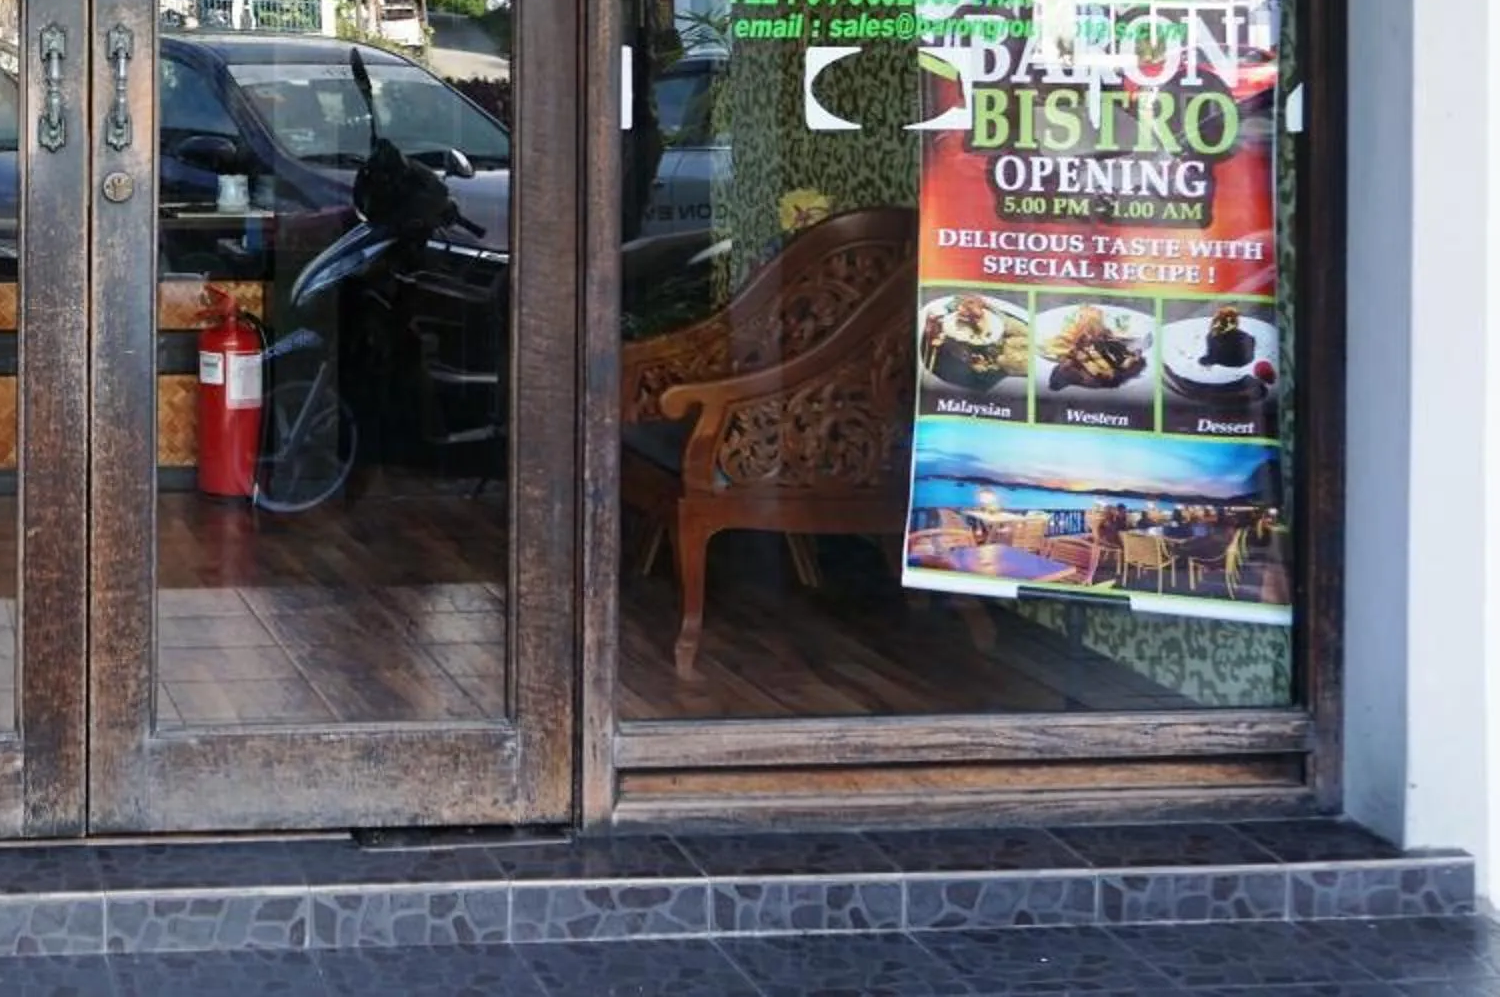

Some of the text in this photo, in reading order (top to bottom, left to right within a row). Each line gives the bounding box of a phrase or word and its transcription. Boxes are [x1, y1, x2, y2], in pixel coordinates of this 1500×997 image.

[734, 13, 806, 39] email
[970, 86, 1241, 155] BISTRO
[994, 155, 1208, 197] OPENING
[1003, 196, 1047, 214] 5.00
[1052, 198, 1090, 216] PM
[1162, 202, 1204, 220] AM
[936, 228, 1265, 261] DELICIOUS TASTE WITH
[983, 255, 1095, 280] SPECIAL
[1102, 264, 1202, 284] RECIPE
[937, 397, 1013, 420] Malaysian
[1066, 408, 1130, 428] Western
[1197, 418, 1255, 436] Dessert
